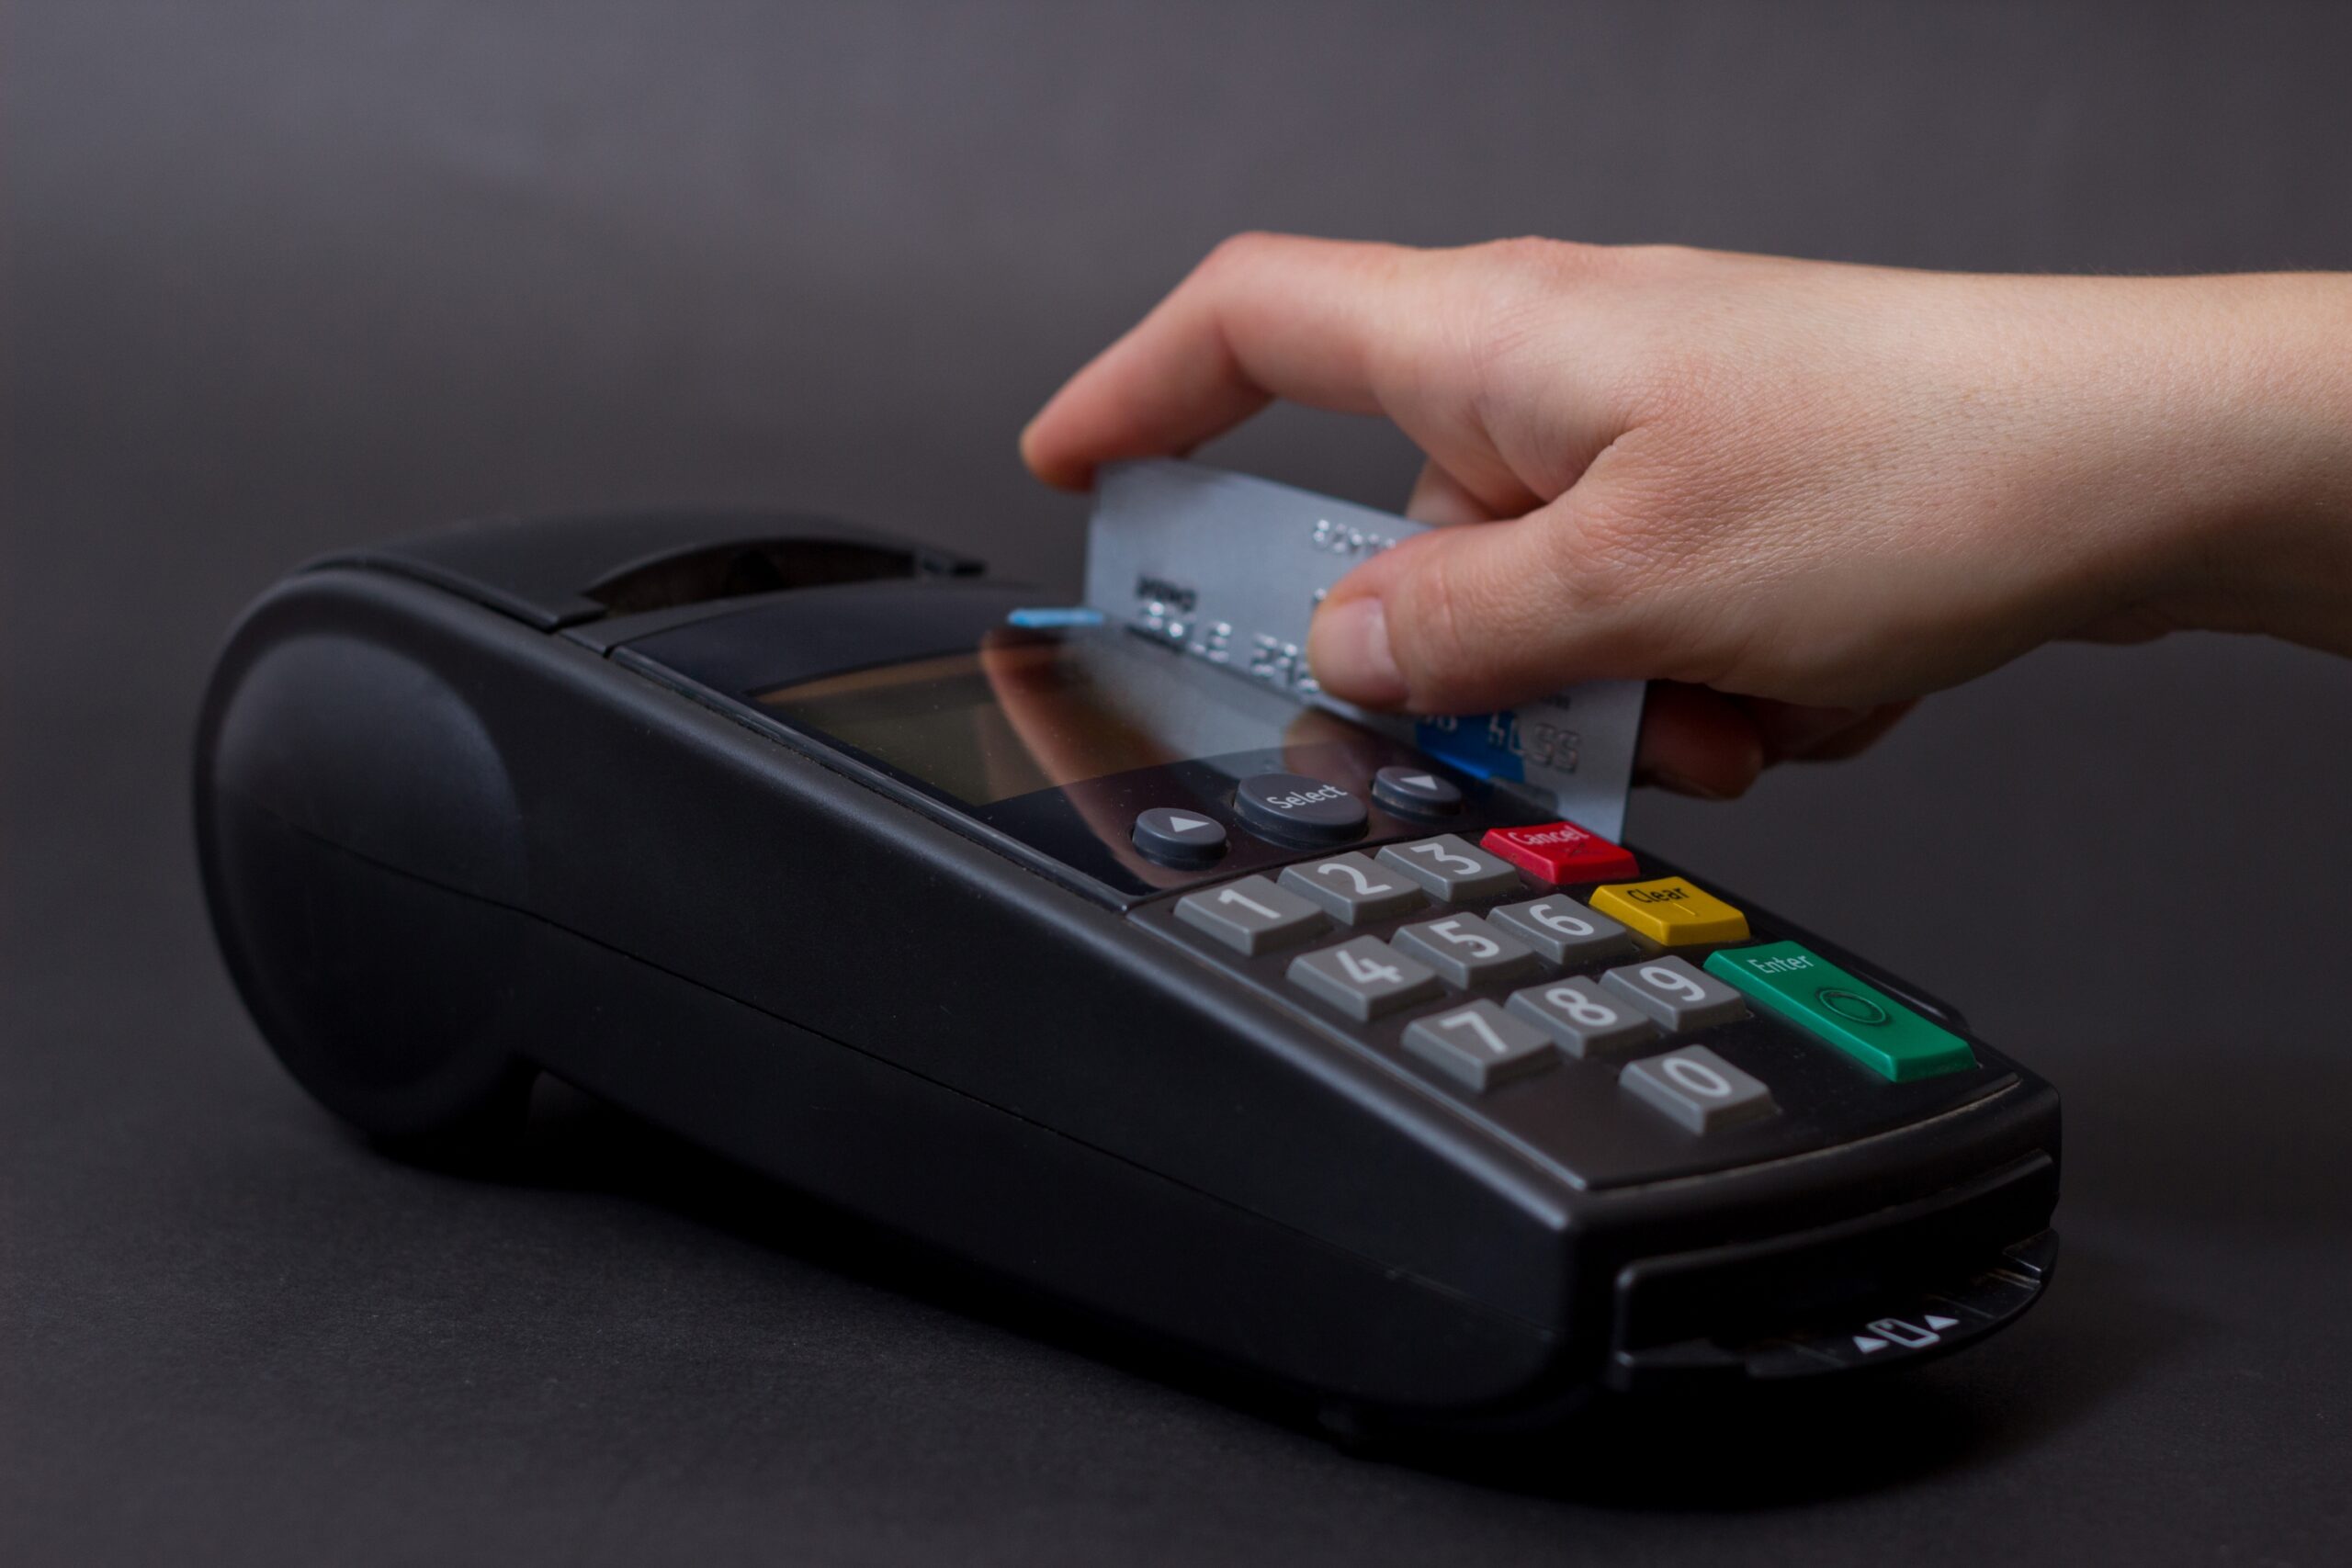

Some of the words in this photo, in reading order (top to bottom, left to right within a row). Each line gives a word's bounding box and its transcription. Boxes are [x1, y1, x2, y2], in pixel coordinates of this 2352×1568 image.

[1267, 784, 1348, 809] Select
[1508, 824, 1589, 847] Cancel
[1410, 842, 1482, 874] 3
[1317, 863, 1393, 895] 2
[1627, 885, 1690, 905] Clear
[1217, 888, 1282, 919] 1
[1529, 904, 1595, 937] 6
[1430, 920, 1499, 958] 5
[1336, 950, 1404, 983] 4
[1747, 952, 1815, 976] Enter
[1639, 965, 1706, 1002] 9
[1544, 987, 1617, 1027] 8
[1440, 1011, 1508, 1054] 7
[1662, 1057, 1732, 1098] 0
